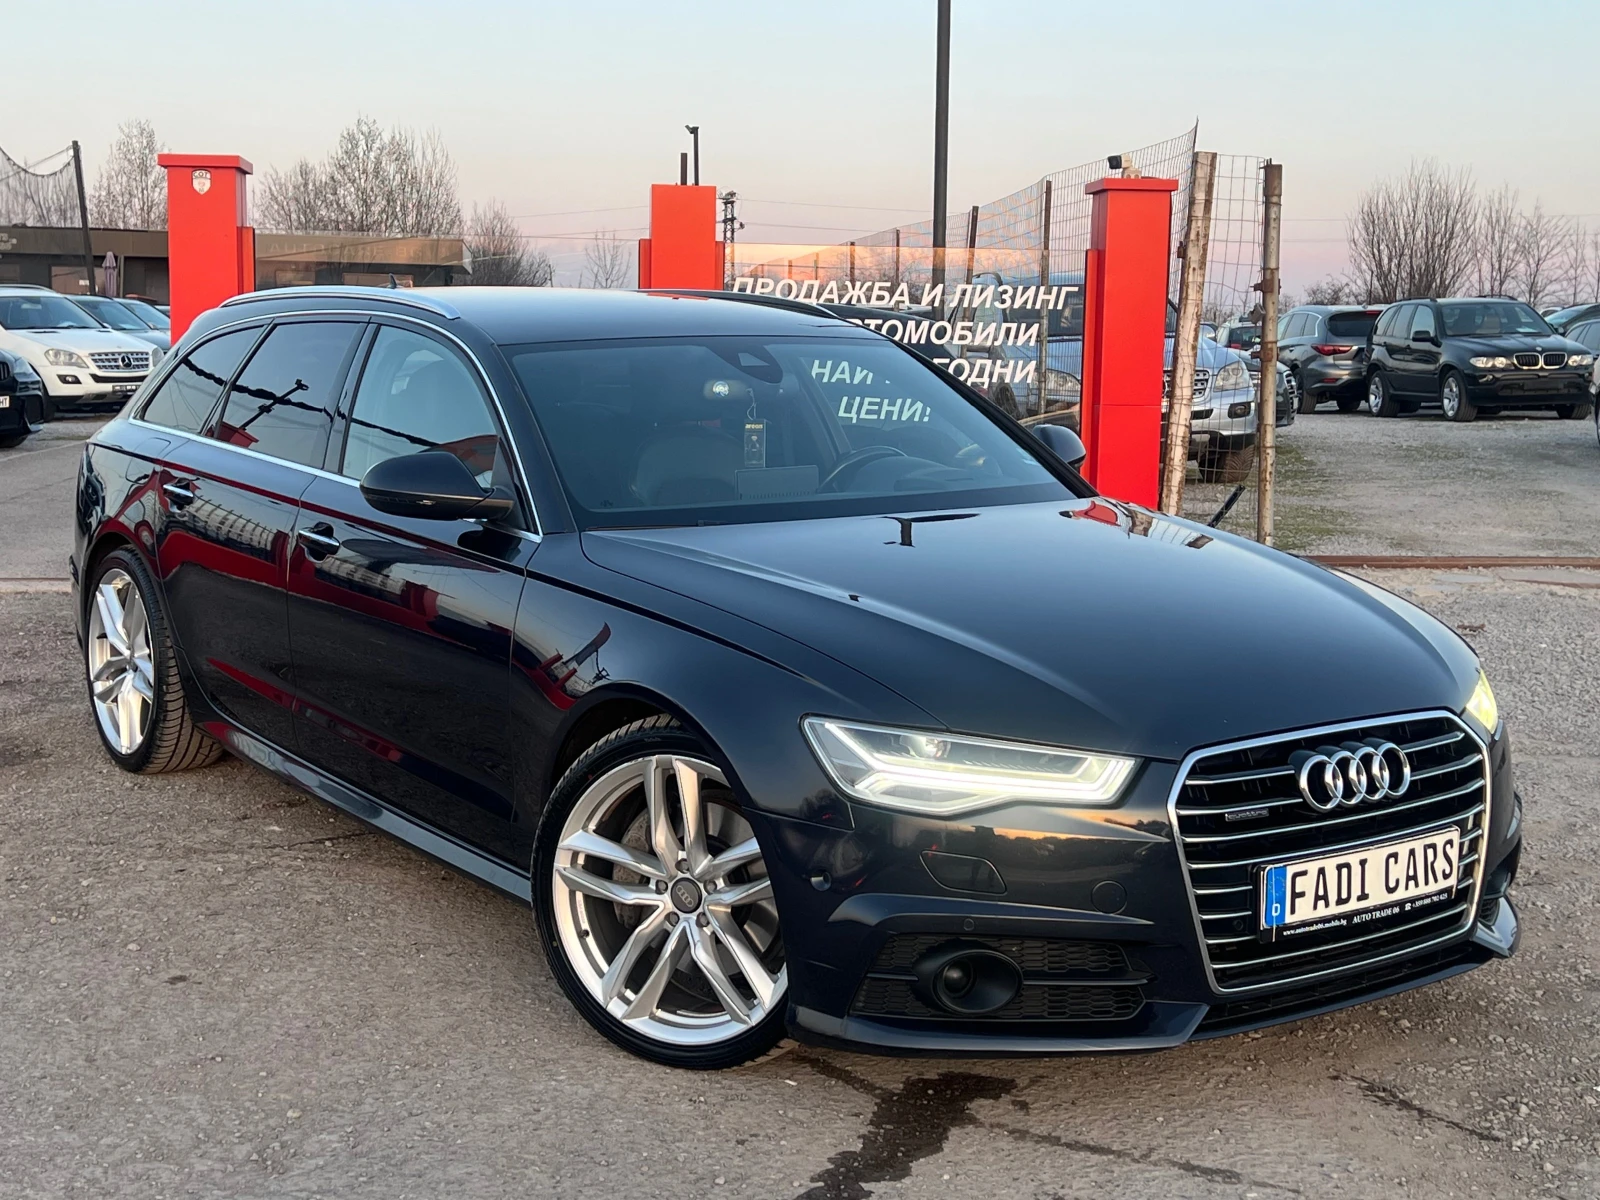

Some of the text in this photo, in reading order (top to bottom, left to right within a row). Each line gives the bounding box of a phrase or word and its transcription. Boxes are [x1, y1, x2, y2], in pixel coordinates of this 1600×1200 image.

[732, 277, 1079, 310] ПРОДАЖБА И ЛИЗИНГ
[846, 318, 1040, 347] ТОМОБИЛИ
[838, 396, 931, 423] ЦЕНИ!
[1290, 839, 1454, 915] FADI CARS
[1271, 903, 1281, 917] D
[1352, 912, 1371, 924] AUTO
[1372, 908, 1392, 919] TRADE
[1392, 906, 1400, 914] 06
